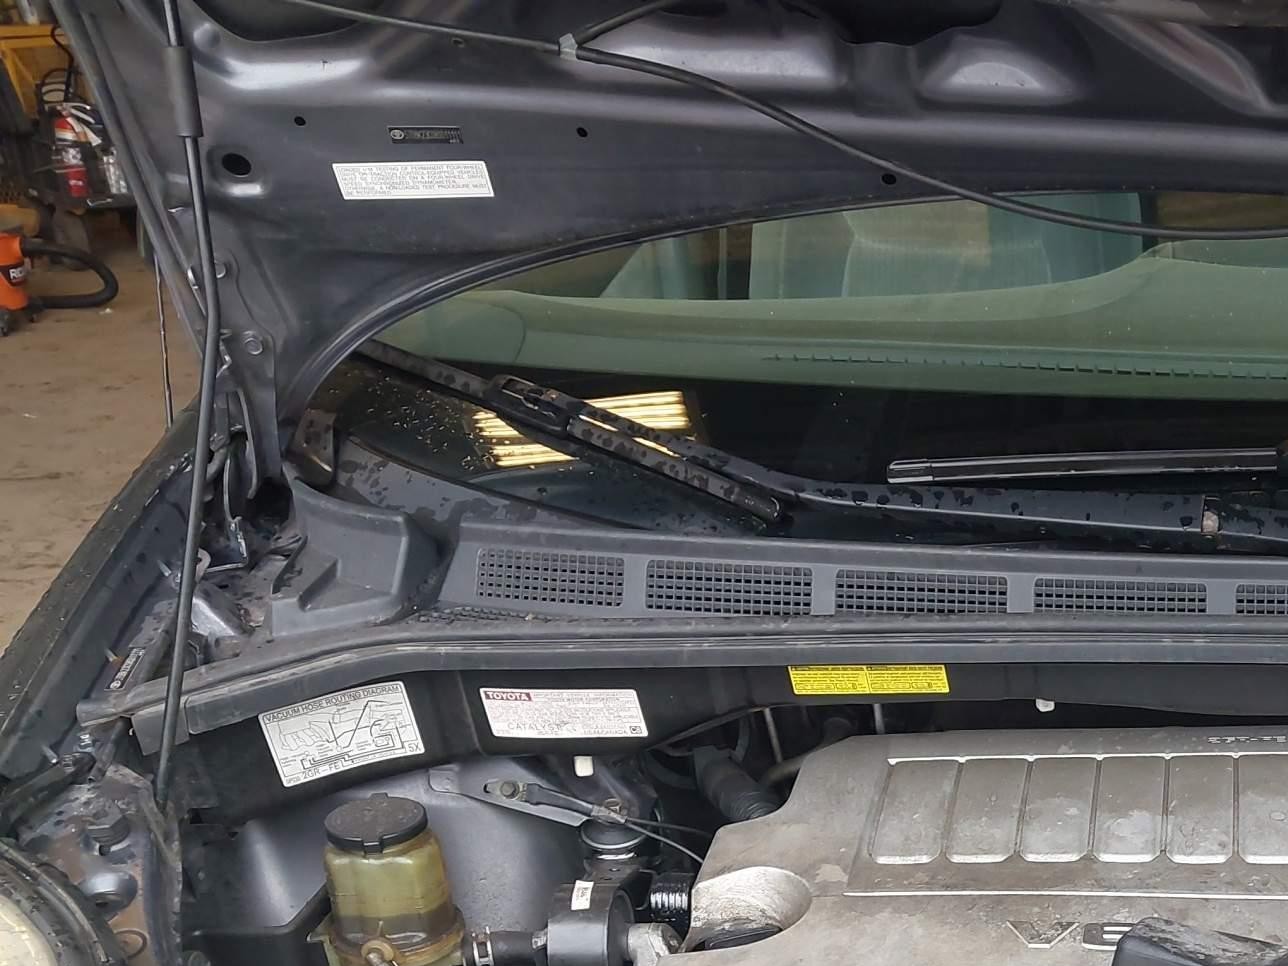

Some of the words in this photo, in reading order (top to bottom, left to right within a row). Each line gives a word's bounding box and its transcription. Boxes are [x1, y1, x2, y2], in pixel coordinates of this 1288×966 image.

[265, 706, 301, 722] VACUUM
[301, 701, 324, 713] HOSE
[325, 691, 362, 706] ROUTING
[362, 685, 400, 700] DIAGRAM
[485, 691, 530, 701] TOYOTA
